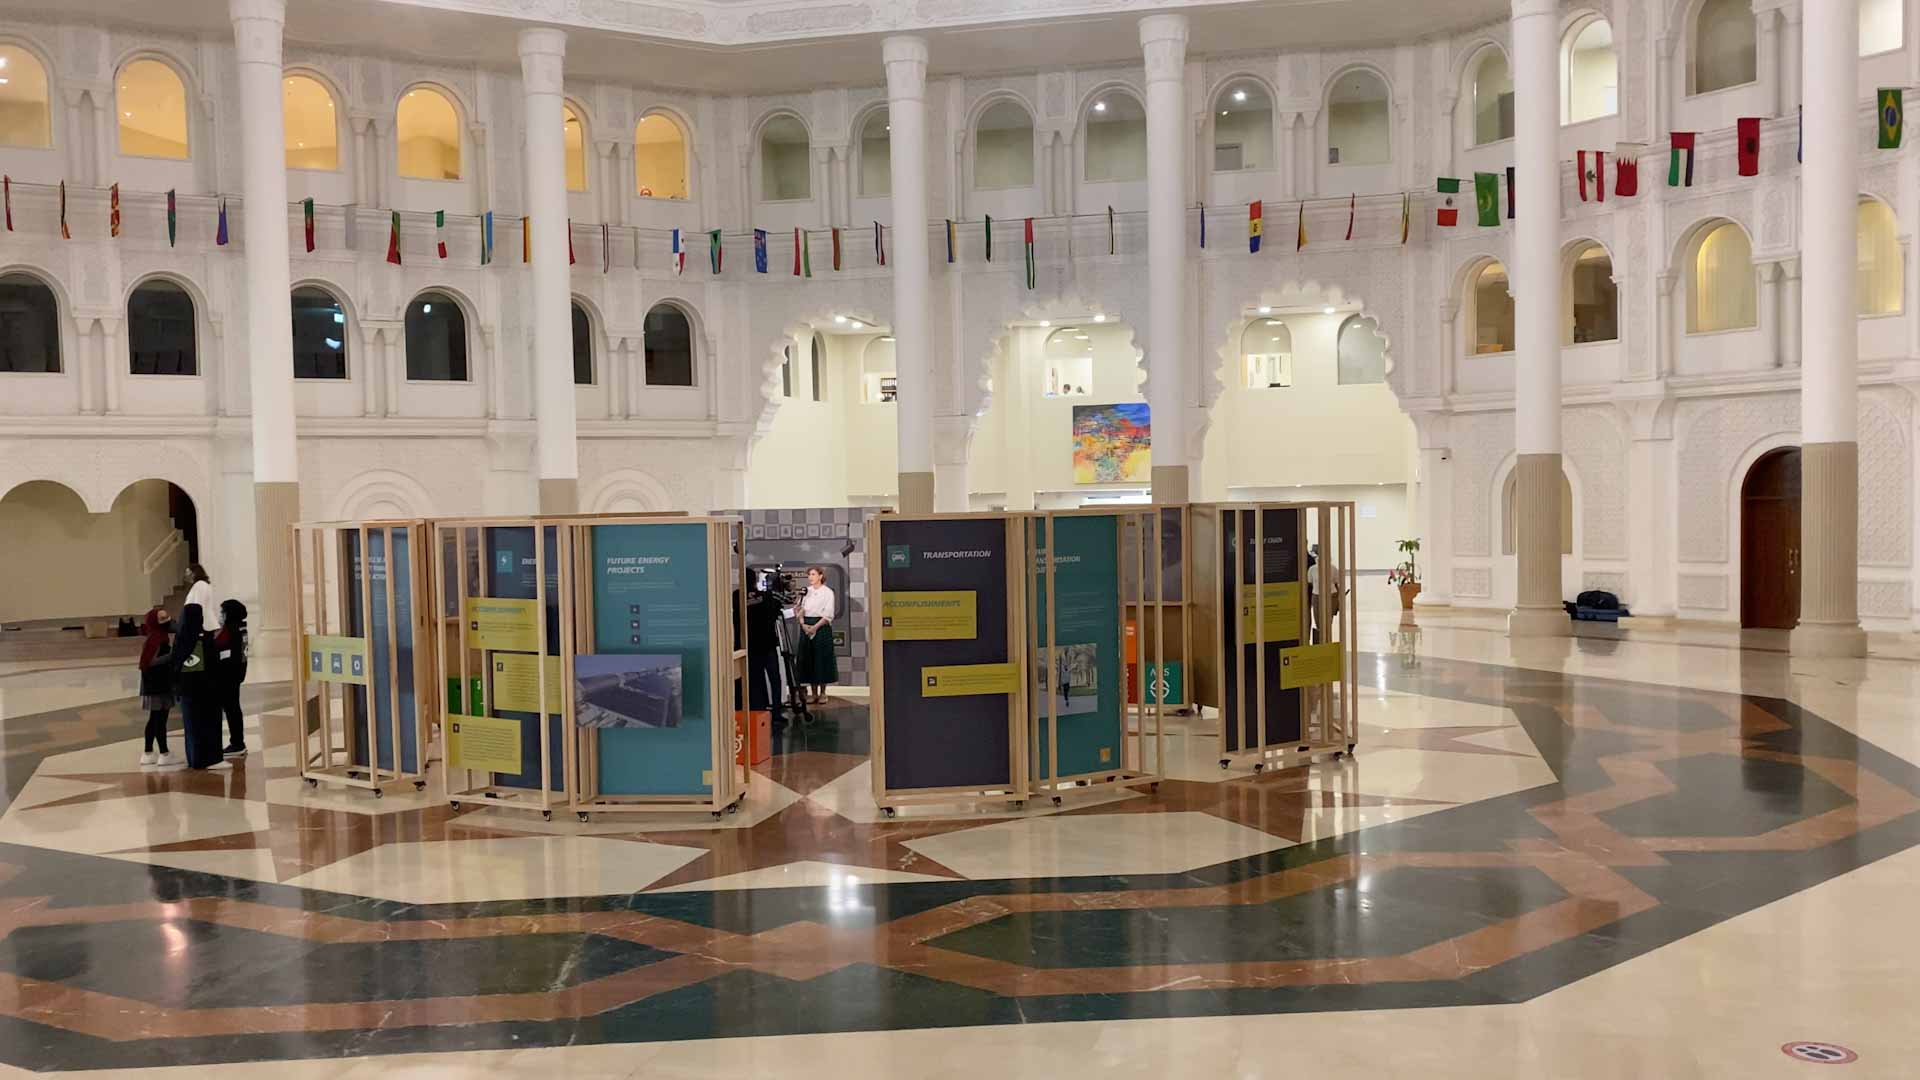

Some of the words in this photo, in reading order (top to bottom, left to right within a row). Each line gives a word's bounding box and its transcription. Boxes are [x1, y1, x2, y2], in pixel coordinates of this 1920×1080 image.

[923, 550, 992, 559] TRANSPORTATION
[607, 557, 636, 565] FUTURE
[638, 556, 670, 565] ENERGY
[607, 566, 645, 574] PROJECTS
[882, 600, 961, 608] ACCOMPLISHMENTS
